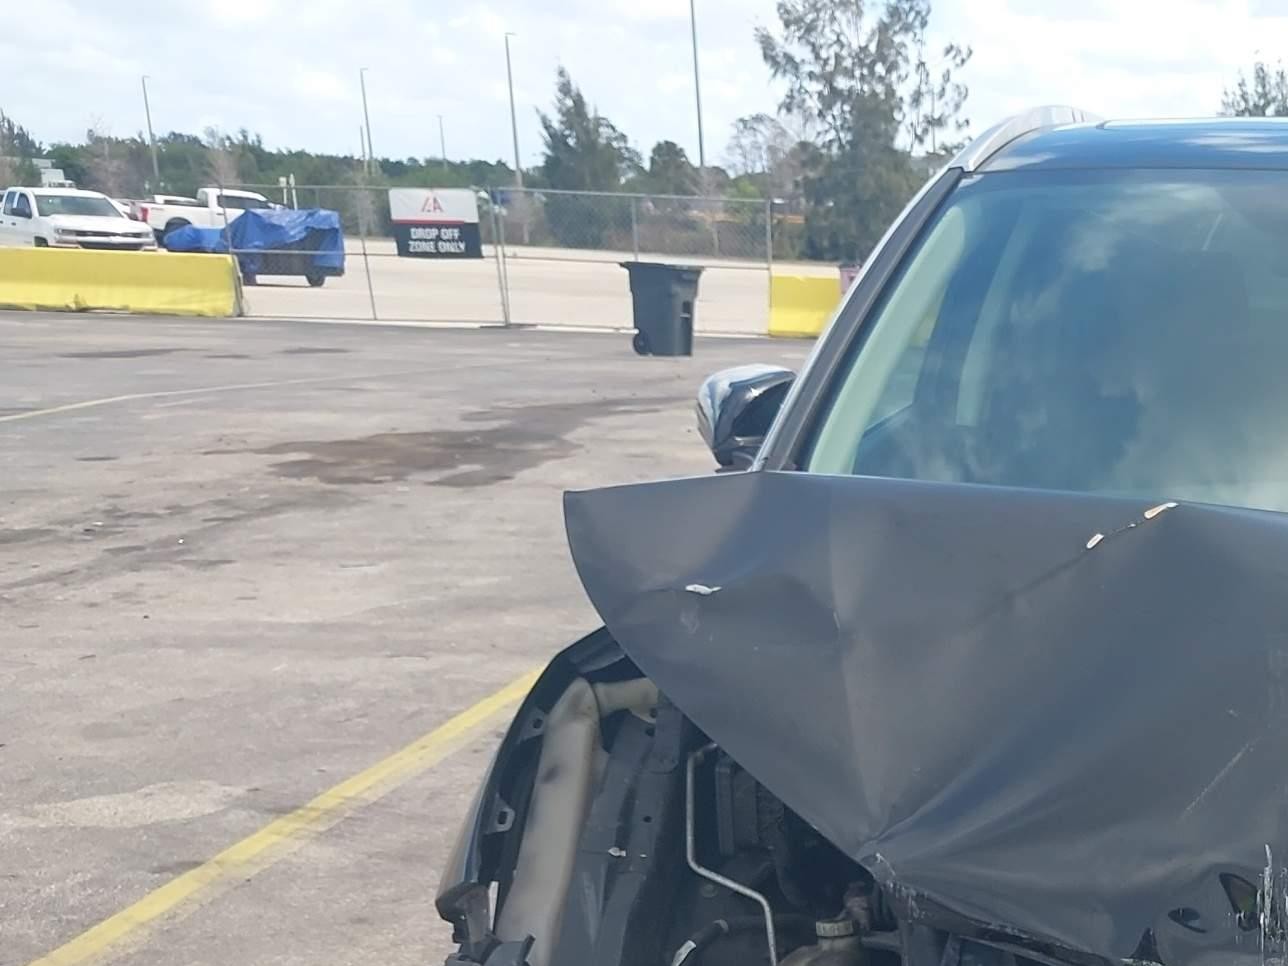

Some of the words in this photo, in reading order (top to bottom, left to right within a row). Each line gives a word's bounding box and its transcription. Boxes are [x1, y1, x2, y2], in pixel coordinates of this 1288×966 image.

[410, 228, 438, 239] DROP
[440, 228, 460, 239] OFF
[408, 241, 436, 252] ZONE
[438, 241, 465, 253] ONLY
